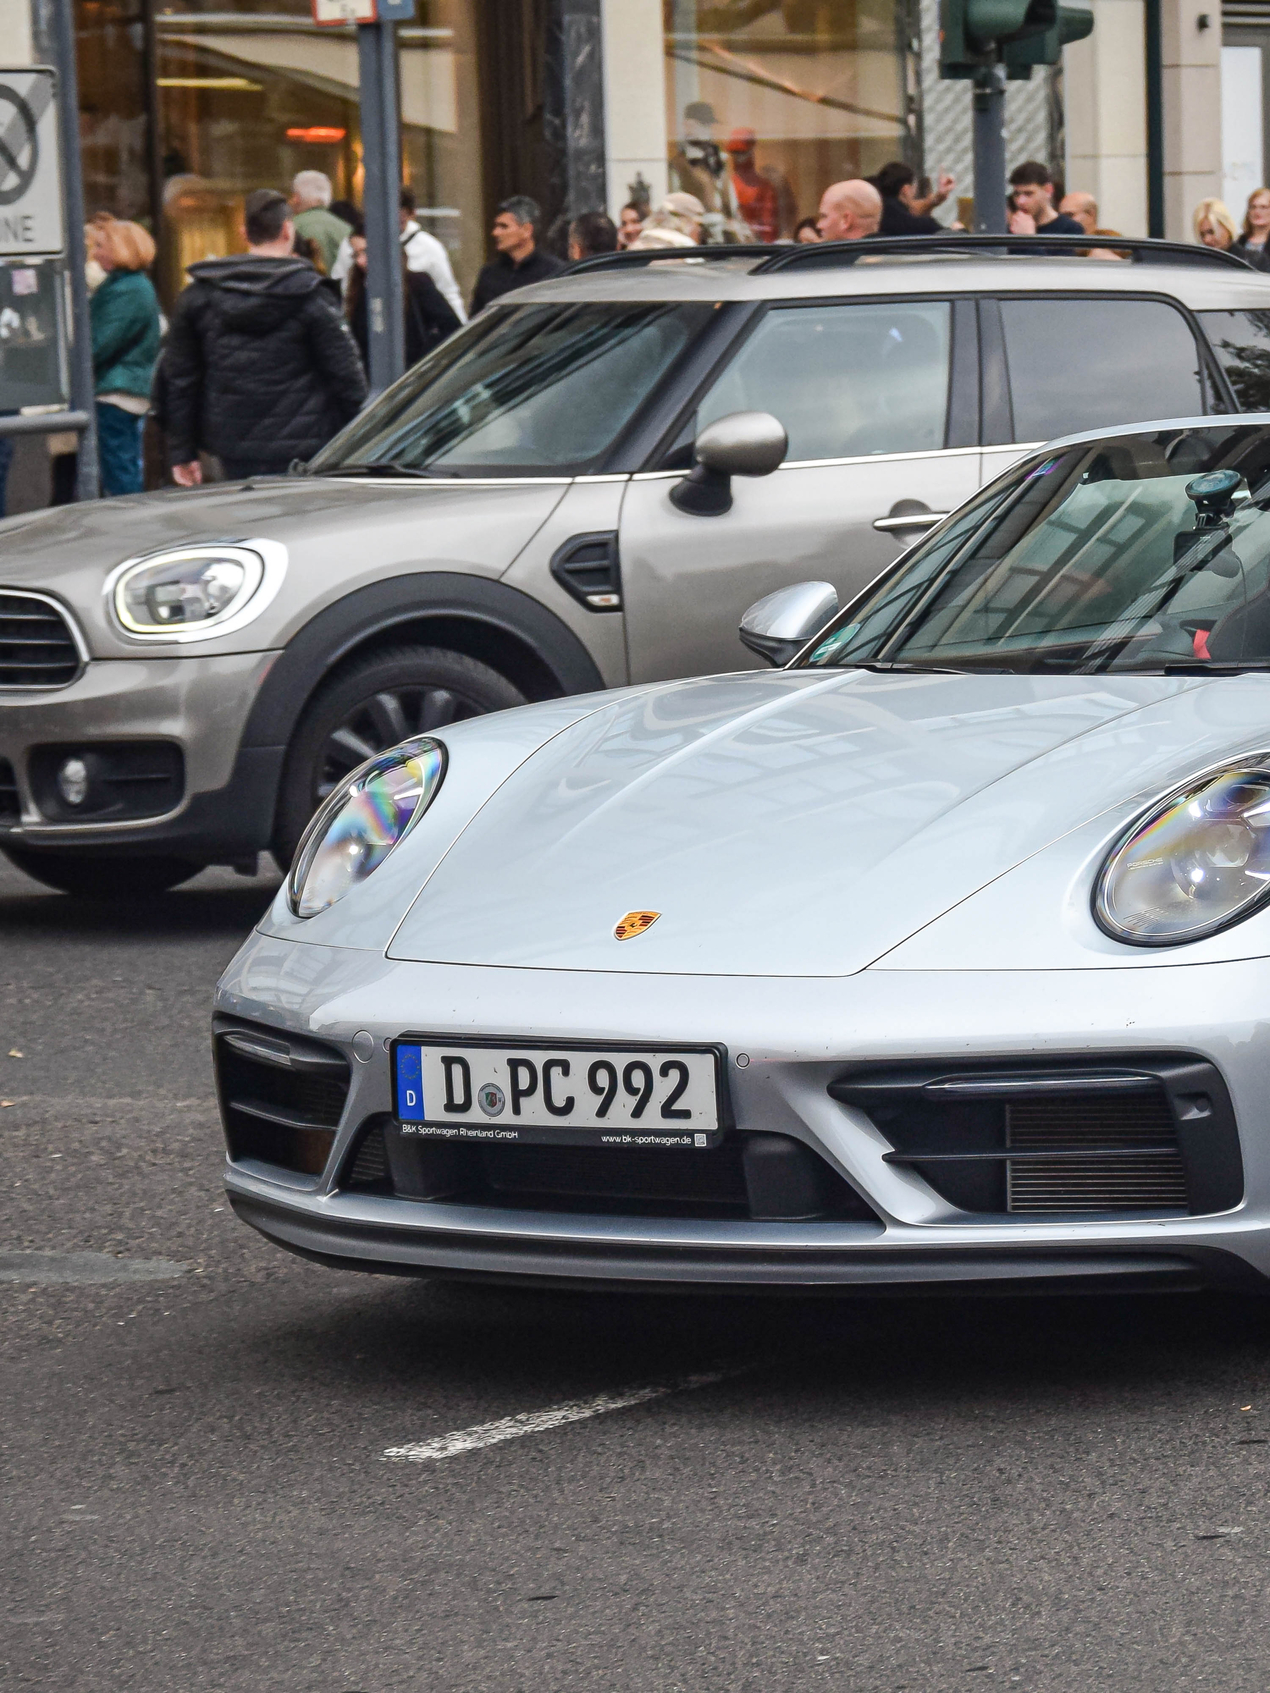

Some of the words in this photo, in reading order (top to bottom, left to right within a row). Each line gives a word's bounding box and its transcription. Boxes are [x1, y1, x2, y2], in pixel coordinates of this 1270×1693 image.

[440, 1055, 473, 1114] D
[506, 1058, 576, 1117] PC
[587, 1060, 693, 1120] 992
[406, 1090, 417, 1107] D
[402, 1124, 417, 1133] B&K
[417, 1125, 459, 1138] Sportwagen
[459, 1127, 494, 1138] Rheinland
[494, 1129, 519, 1139] GmbH
[601, 1134, 692, 1147] www.bk-sportwagen.de
